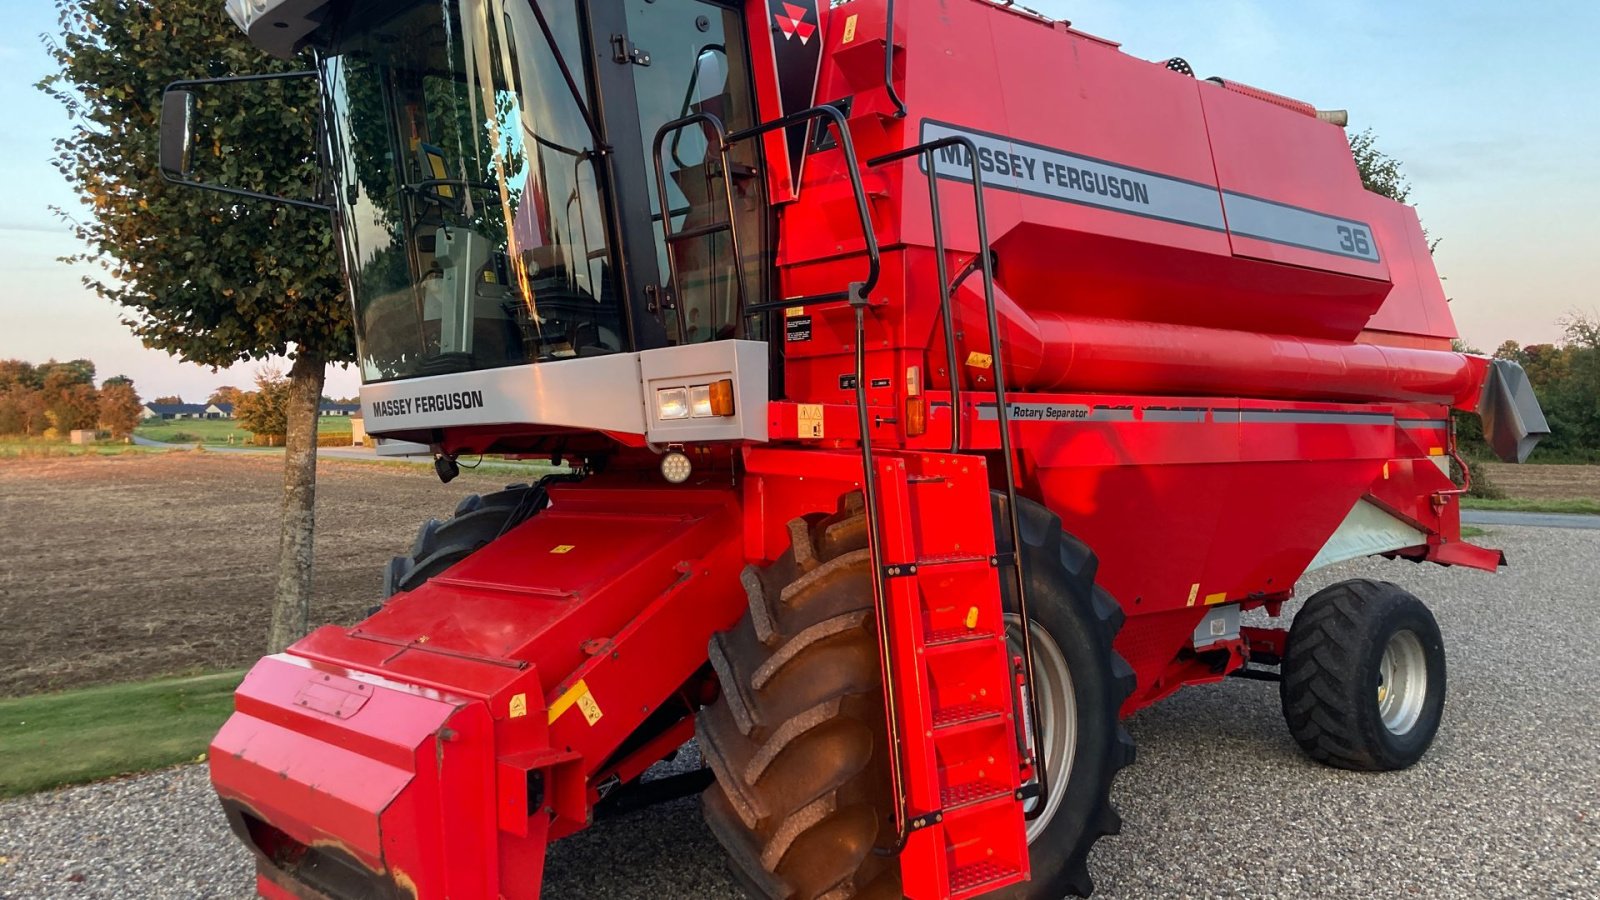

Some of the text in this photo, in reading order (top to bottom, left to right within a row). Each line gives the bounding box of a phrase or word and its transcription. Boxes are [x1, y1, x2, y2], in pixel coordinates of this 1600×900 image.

[1042, 161, 1150, 205] FERGUSON
[1336, 224, 1370, 255] 36
[372, 390, 484, 418] MASSEY FERGUSON
[1013, 406, 1088, 420] Rotary Separator
